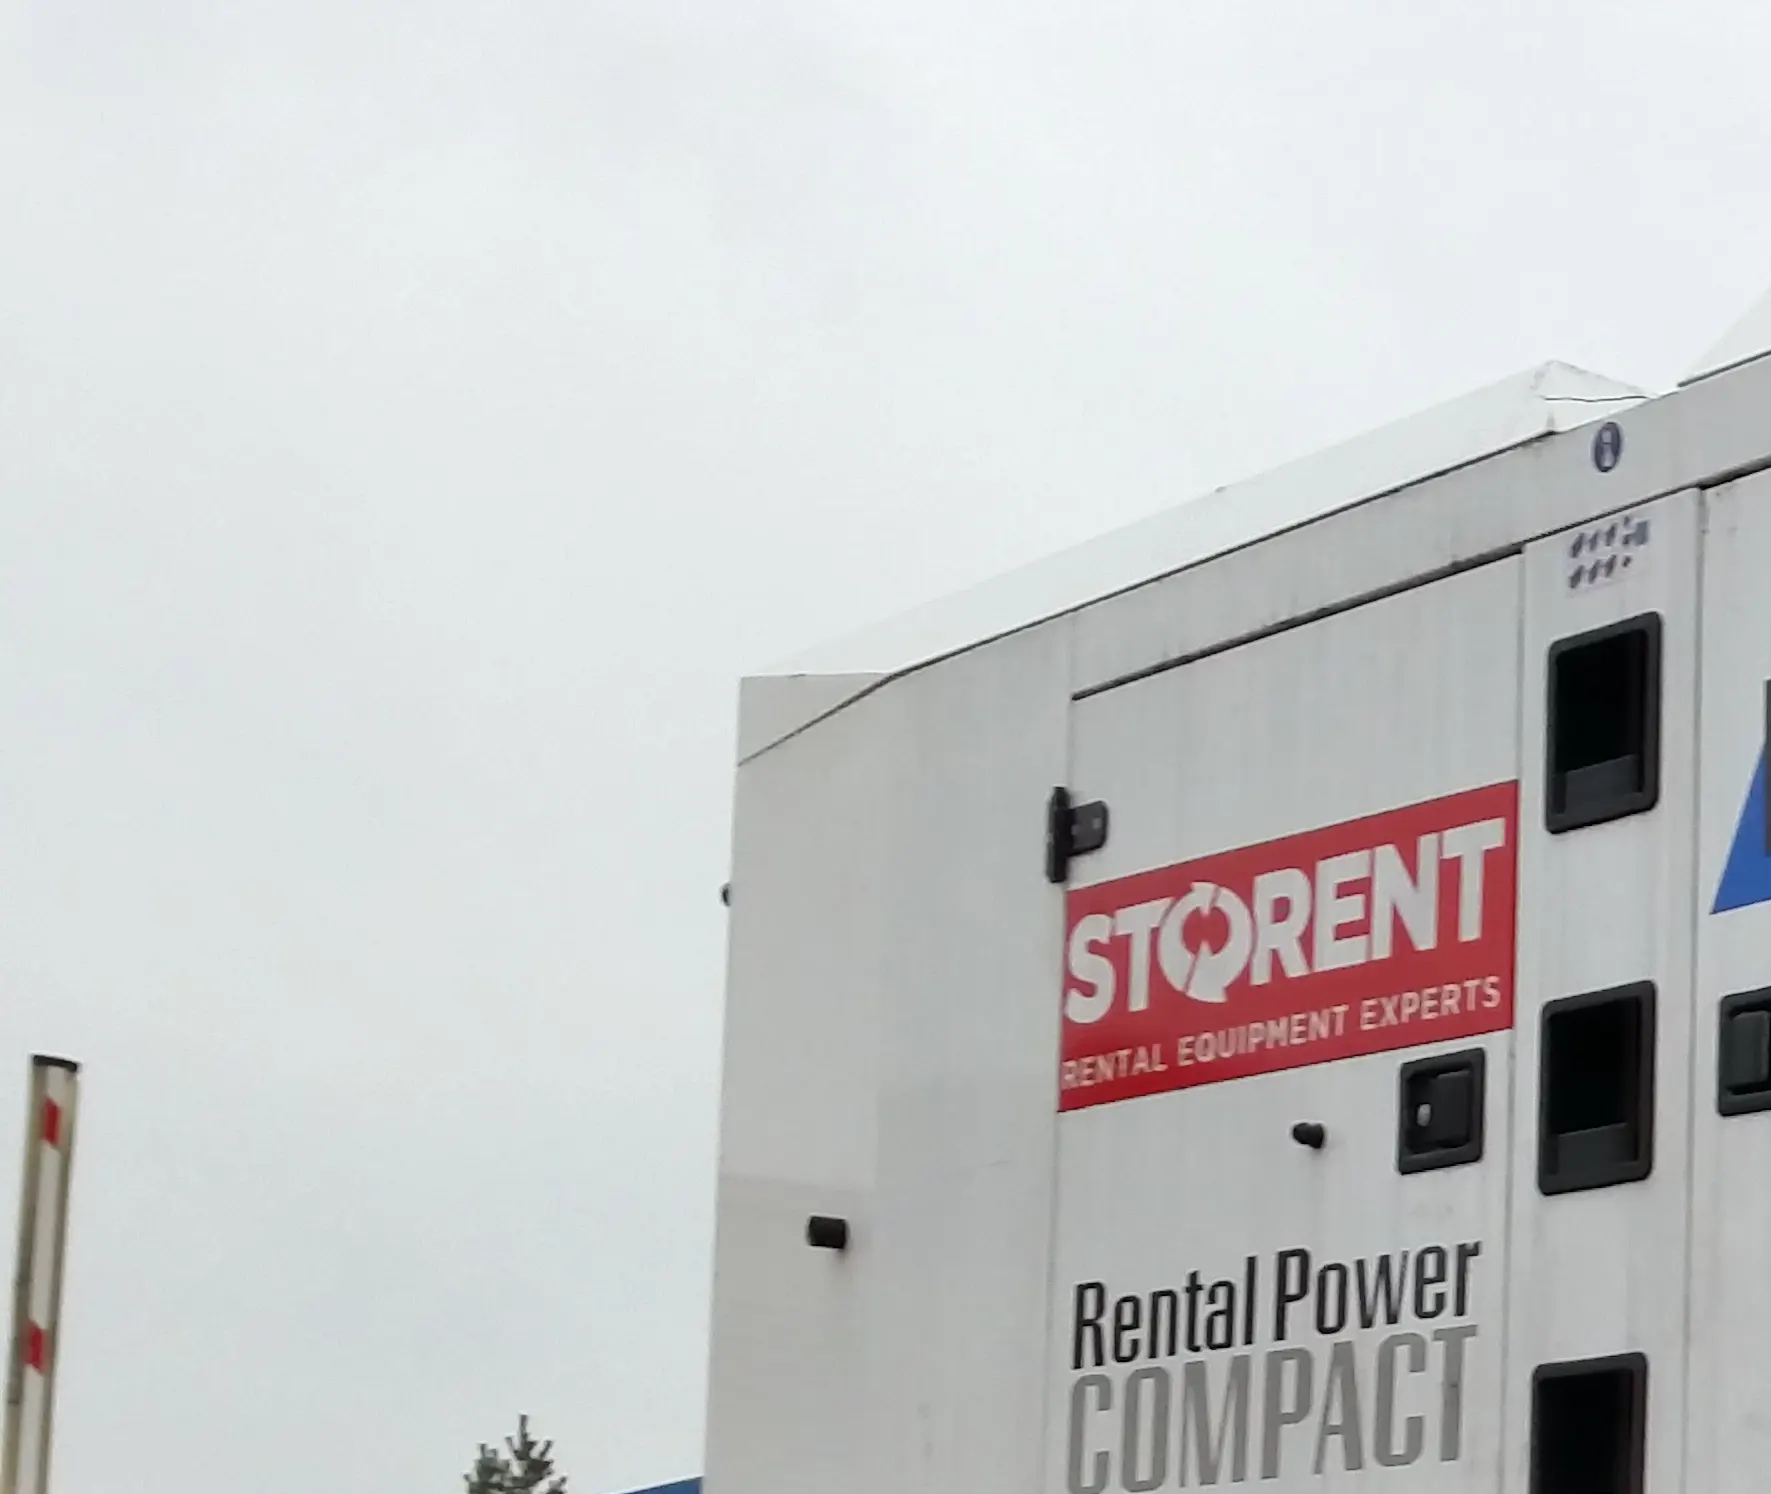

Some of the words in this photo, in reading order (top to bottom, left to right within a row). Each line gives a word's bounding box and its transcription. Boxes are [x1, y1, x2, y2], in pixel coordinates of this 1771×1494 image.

[1063, 817, 1506, 1025] STORENT
[1061, 1045, 1168, 1091] RENTAL
[1177, 1003, 1347, 1068] EQUIPMENT
[1359, 975, 1502, 1032] EXPERTS
[1071, 1253, 1258, 1371] Rental
[1273, 1239, 1484, 1341] Power
